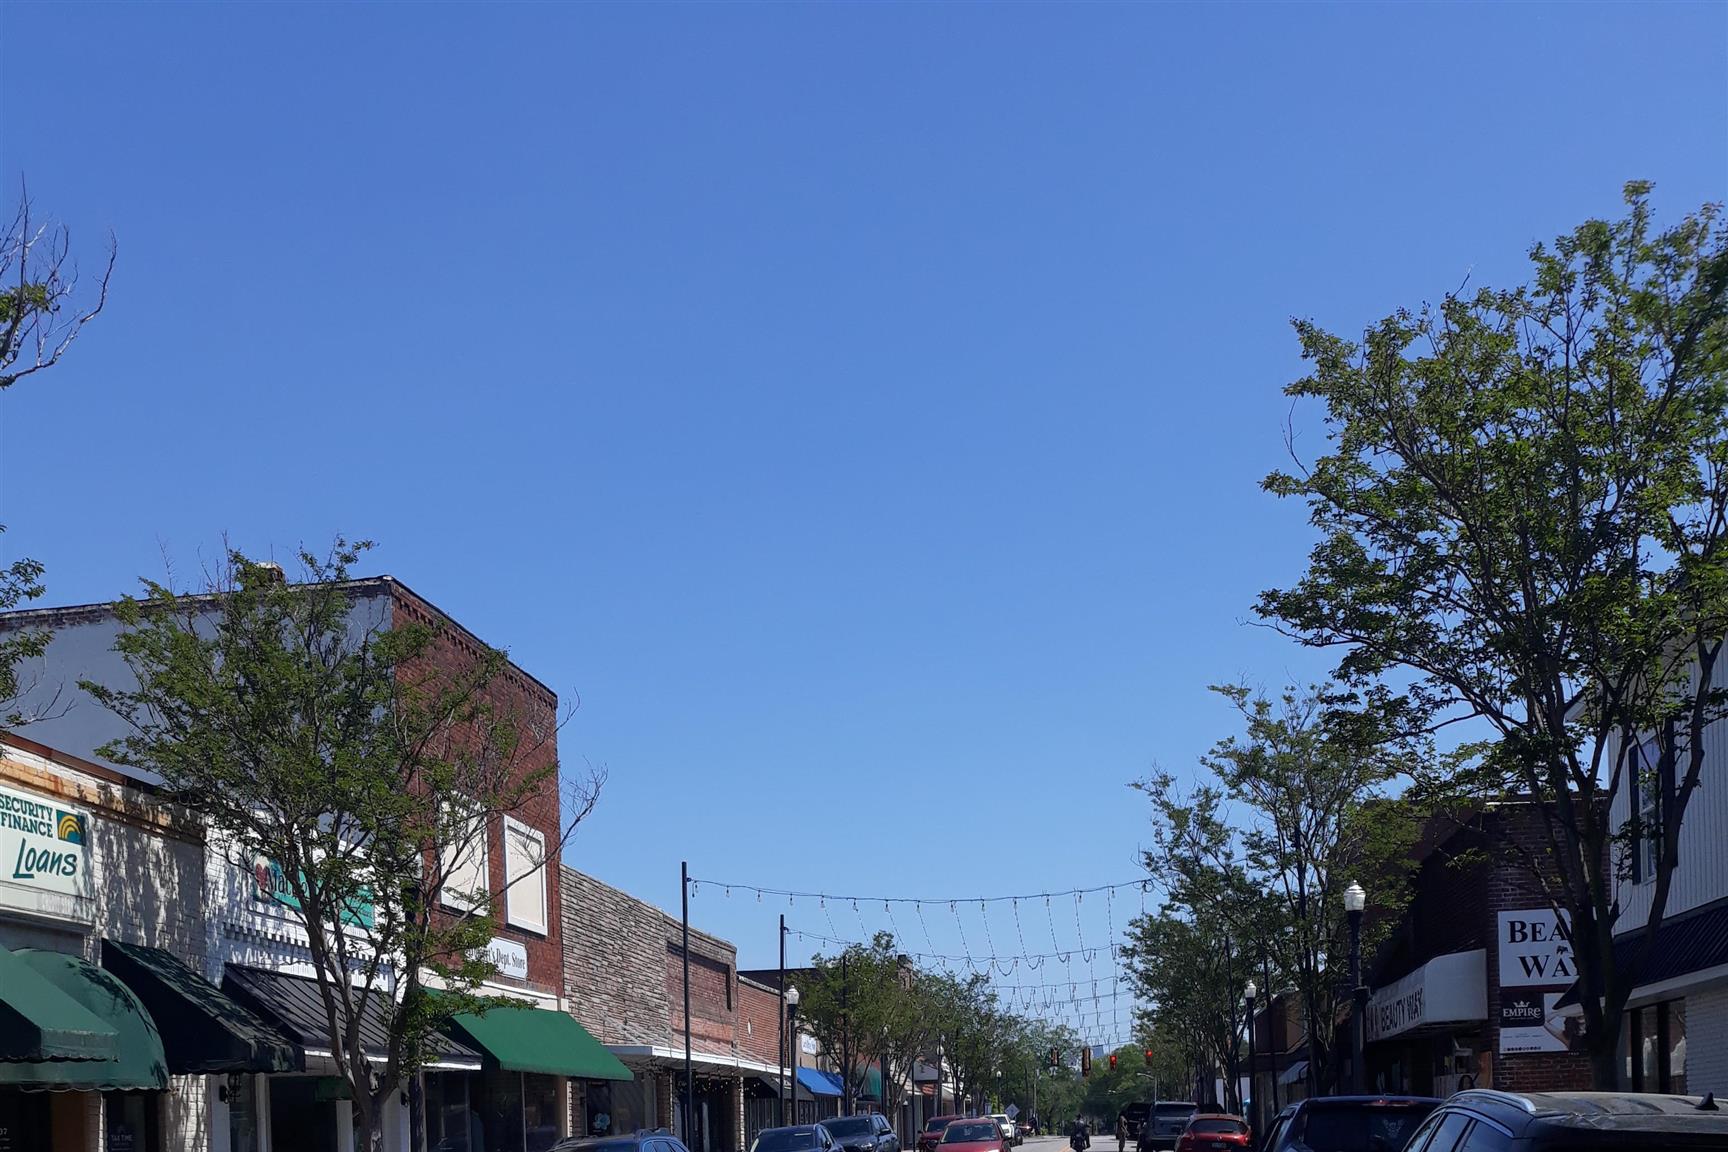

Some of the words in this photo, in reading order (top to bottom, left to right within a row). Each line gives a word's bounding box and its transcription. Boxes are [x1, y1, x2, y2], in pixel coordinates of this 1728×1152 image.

[0, 793, 53, 821] SECURITY
[0, 812, 53, 838] FINANCE
[13, 837, 77, 879] Loans
[1507, 920, 1571, 943] BEA
[511, 952, 526, 970] Store
[1381, 997, 1406, 1032] BEAUTY
[1406, 987, 1423, 1021] WAY
